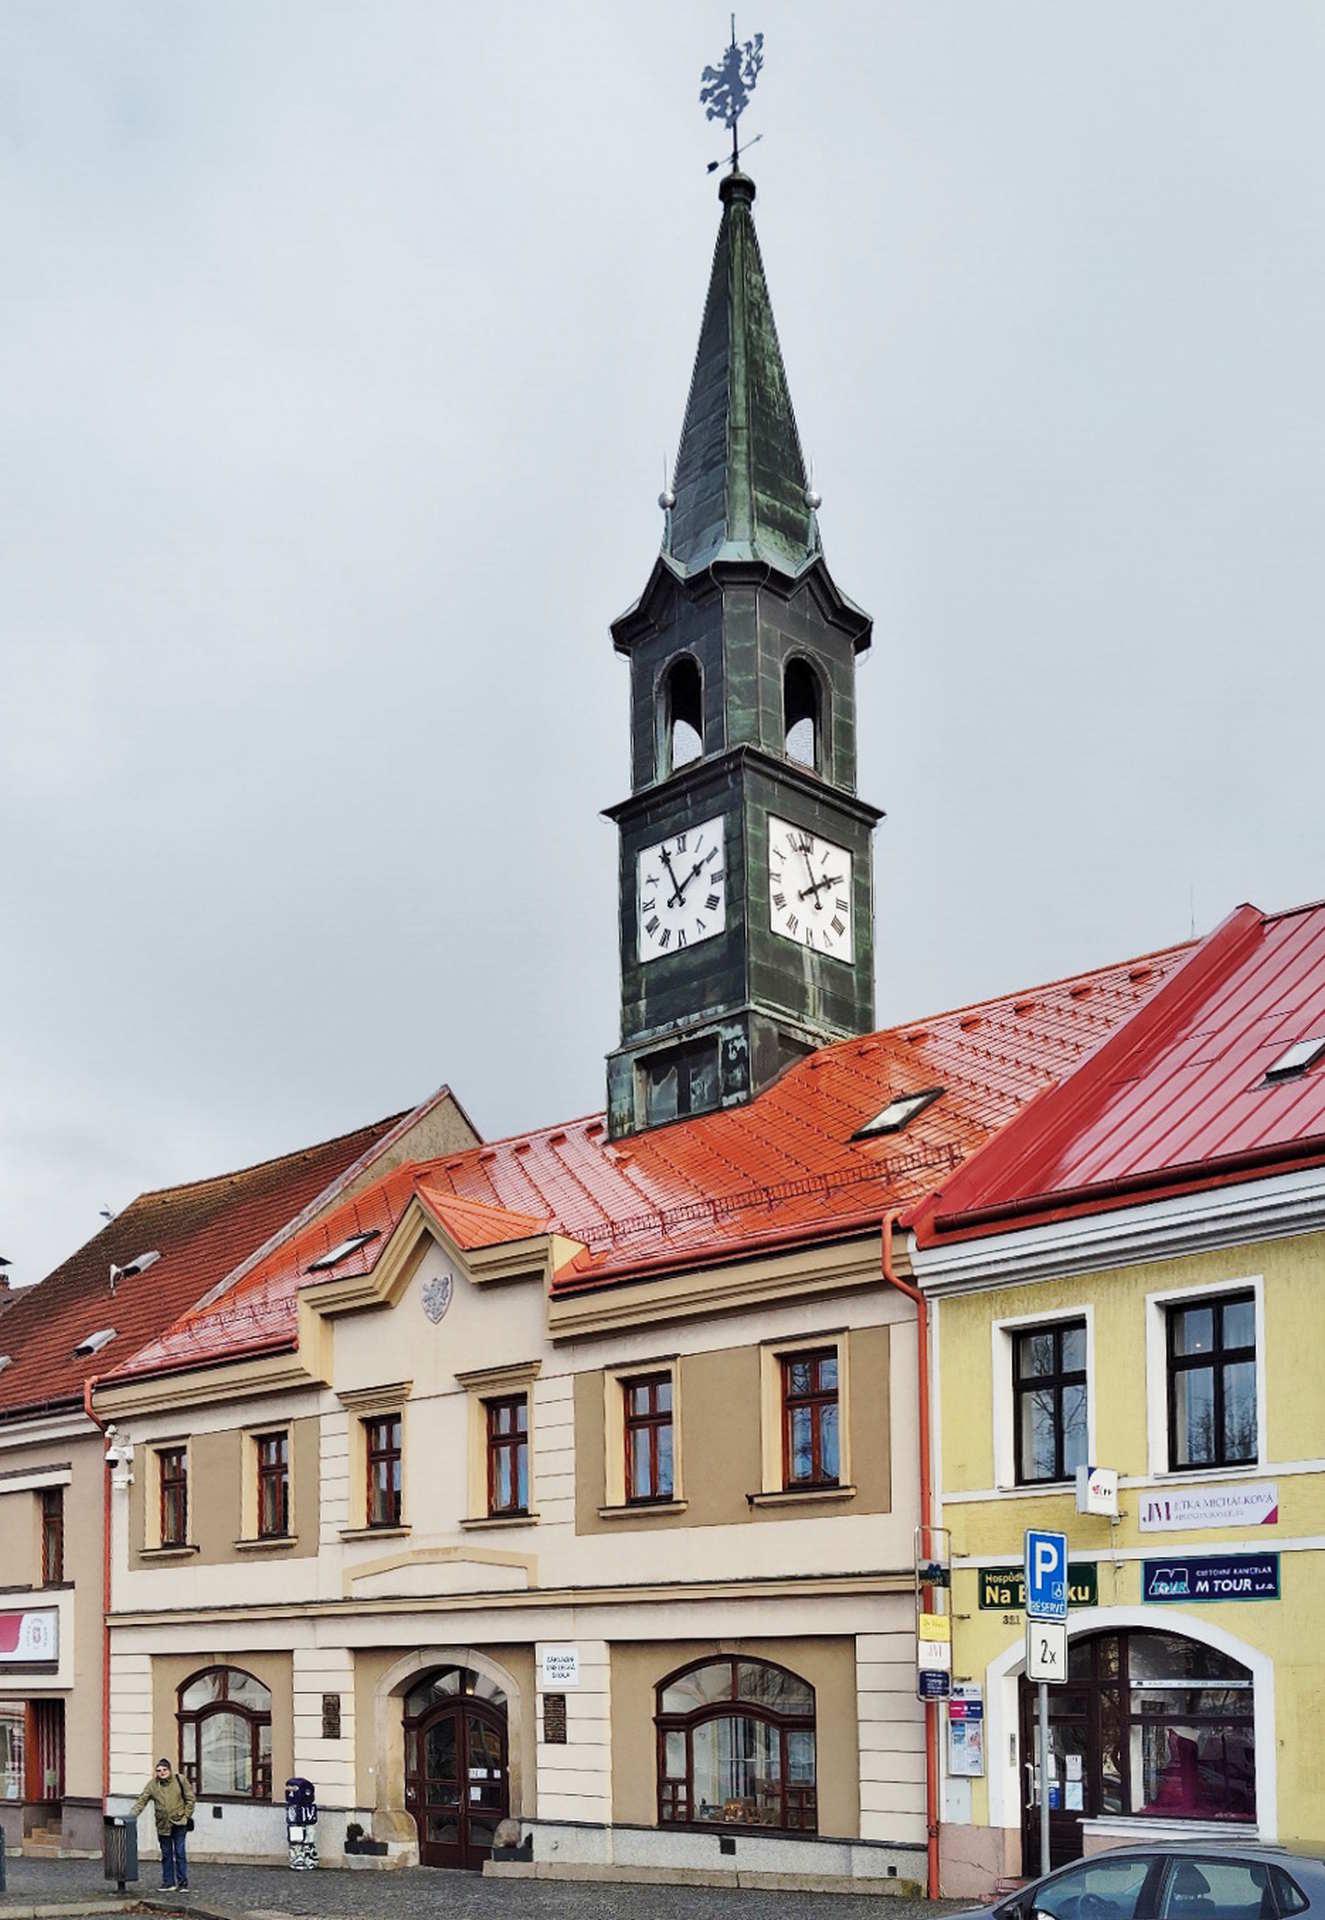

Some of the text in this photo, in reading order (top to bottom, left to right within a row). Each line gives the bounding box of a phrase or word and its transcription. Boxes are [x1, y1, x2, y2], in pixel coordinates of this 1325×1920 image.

[1035, 1541, 1058, 1590] P
[985, 1585, 1011, 1604] Na
[1195, 1580, 1210, 1593] M
[1213, 1578, 1252, 1592] TOUR
[1040, 1639, 1057, 1664] 2x
